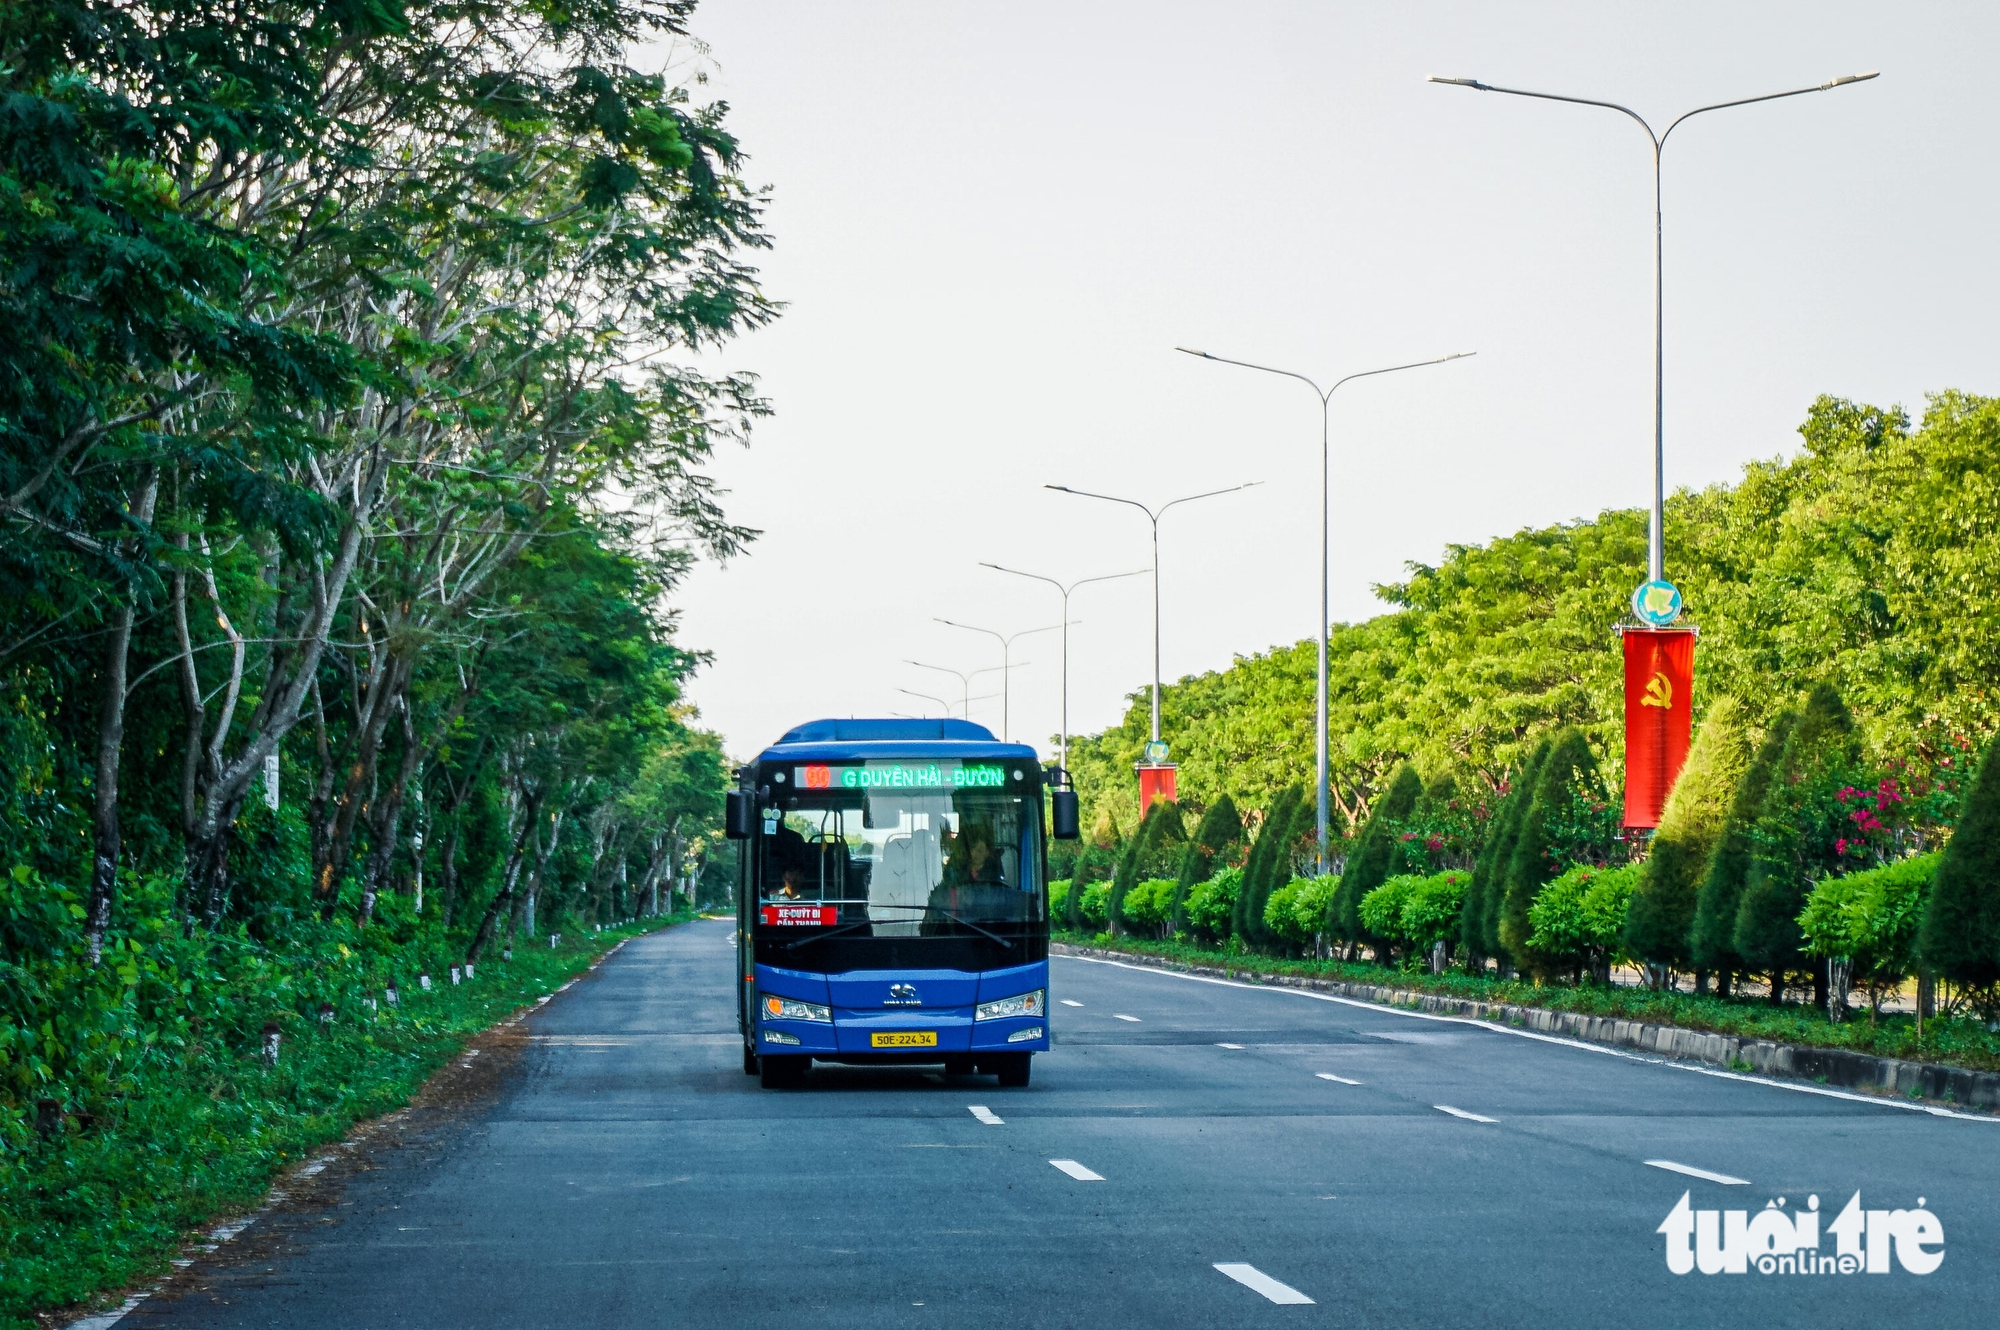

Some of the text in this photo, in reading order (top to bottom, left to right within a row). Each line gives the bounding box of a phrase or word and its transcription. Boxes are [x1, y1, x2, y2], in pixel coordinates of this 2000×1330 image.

[805, 765, 830, 788] 90
[843, 768, 857, 788] G
[859, 764, 914, 787] DUYÊN
[917, 764, 942, 787] HẢI
[778, 909, 789, 918] XE
[877, 1035, 932, 1046] 50E-224.34
